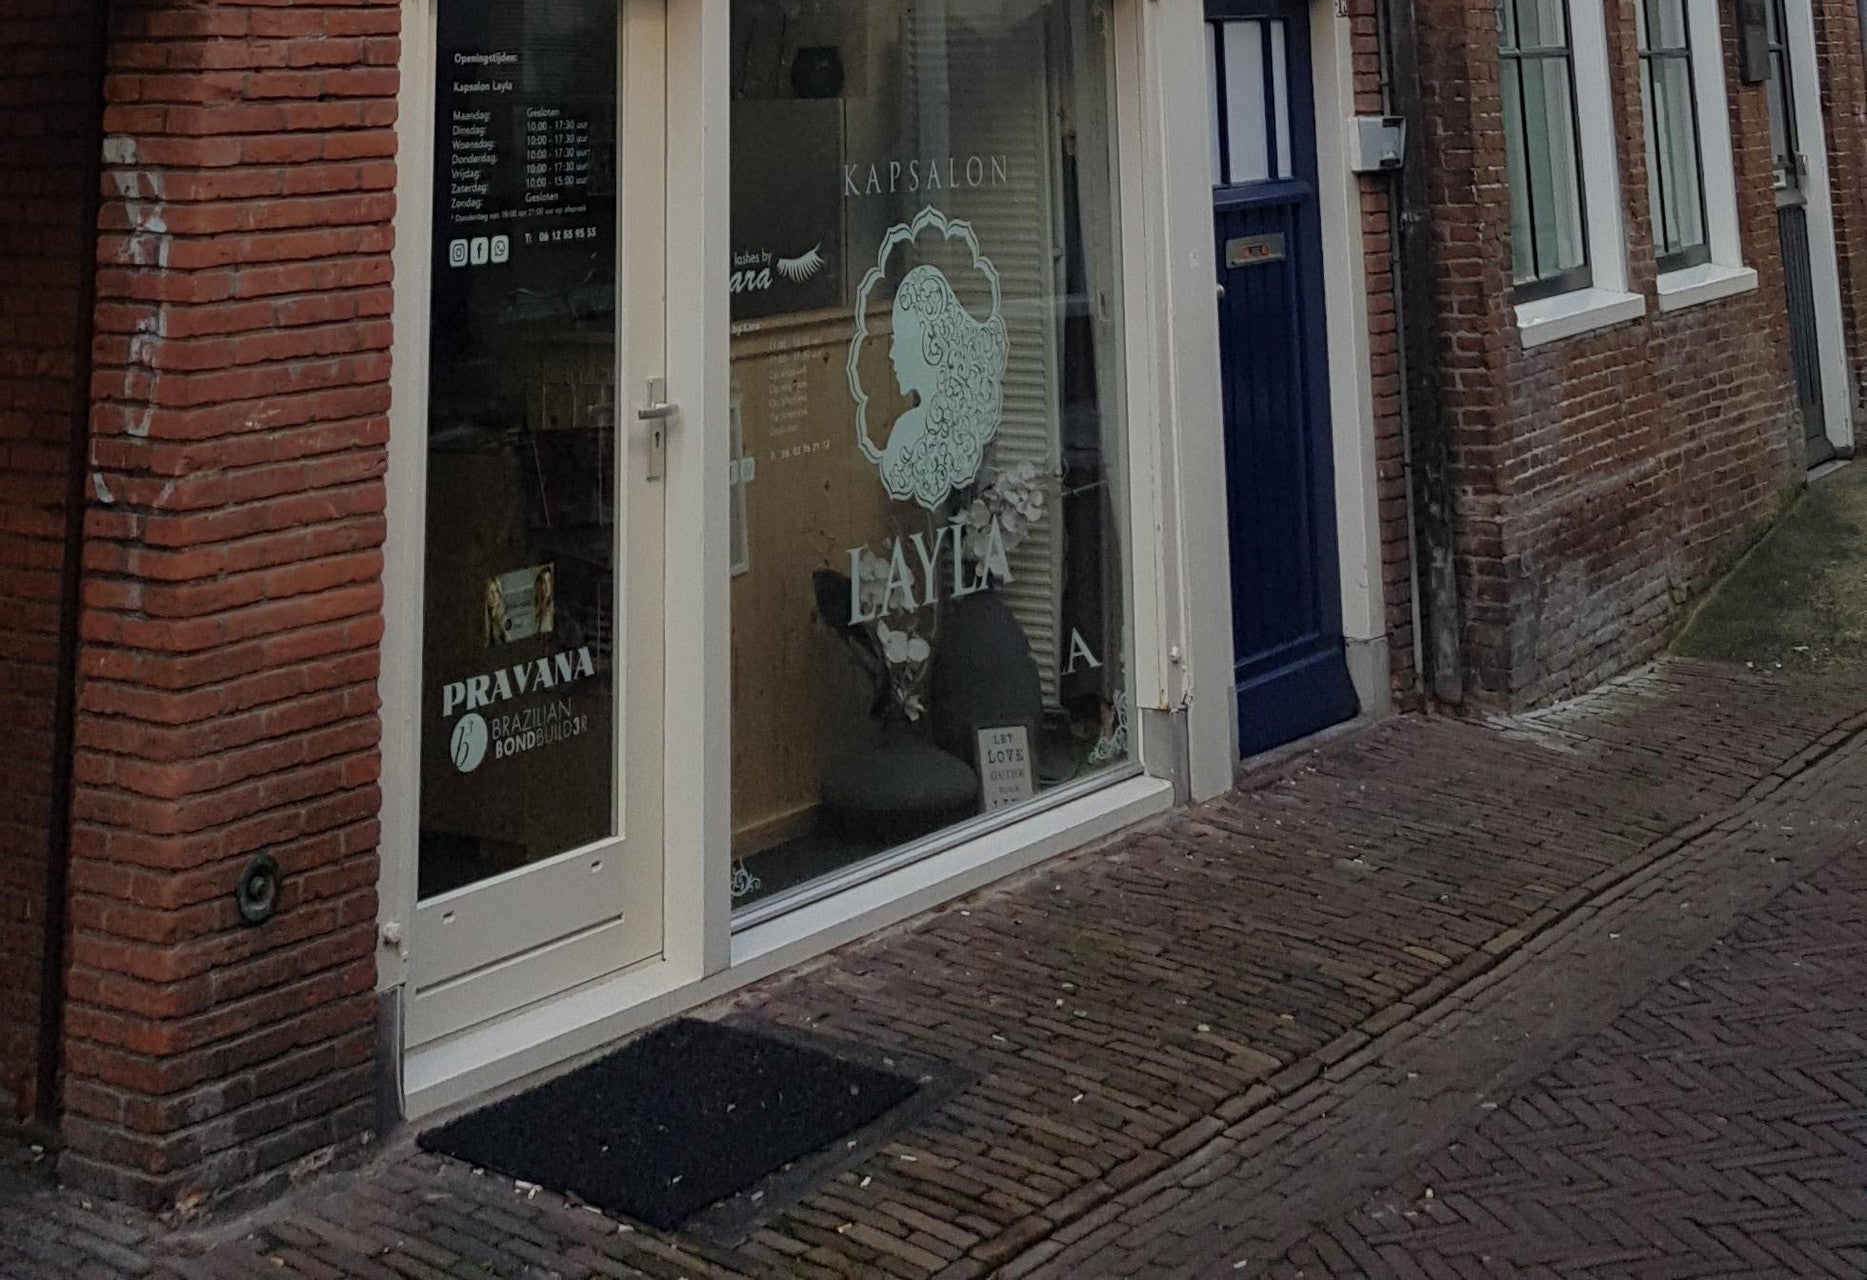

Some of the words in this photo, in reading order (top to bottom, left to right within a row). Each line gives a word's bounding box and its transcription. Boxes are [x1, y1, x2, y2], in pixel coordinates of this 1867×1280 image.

[454, 51, 519, 65] Openingstijden:
[453, 81, 490, 93] Kapsalon
[492, 80, 513, 93] Layla
[453, 110, 491, 122] Maandag:
[527, 108, 560, 118] Gesloten
[453, 125, 487, 136] Dinsdag:
[452, 140, 495, 151] Woensdag:
[452, 153, 498, 165] Donderdag:
[452, 168, 482, 180] Vrijdag:
[844, 154, 1007, 196] KAPSALON
[451, 183, 489, 194] Zaterdag:
[451, 198, 483, 209] Zondag:
[525, 192, 559, 203] Gesloten
[762, 248, 772, 265] by
[730, 267, 773, 293] ara
[847, 513, 1016, 626] LAYLA
[442, 645, 595, 718] PRAVANA
[491, 697, 571, 740] BRAZILIAN
[993, 733, 1012, 745] LET
[988, 749, 1024, 764] LOVE
